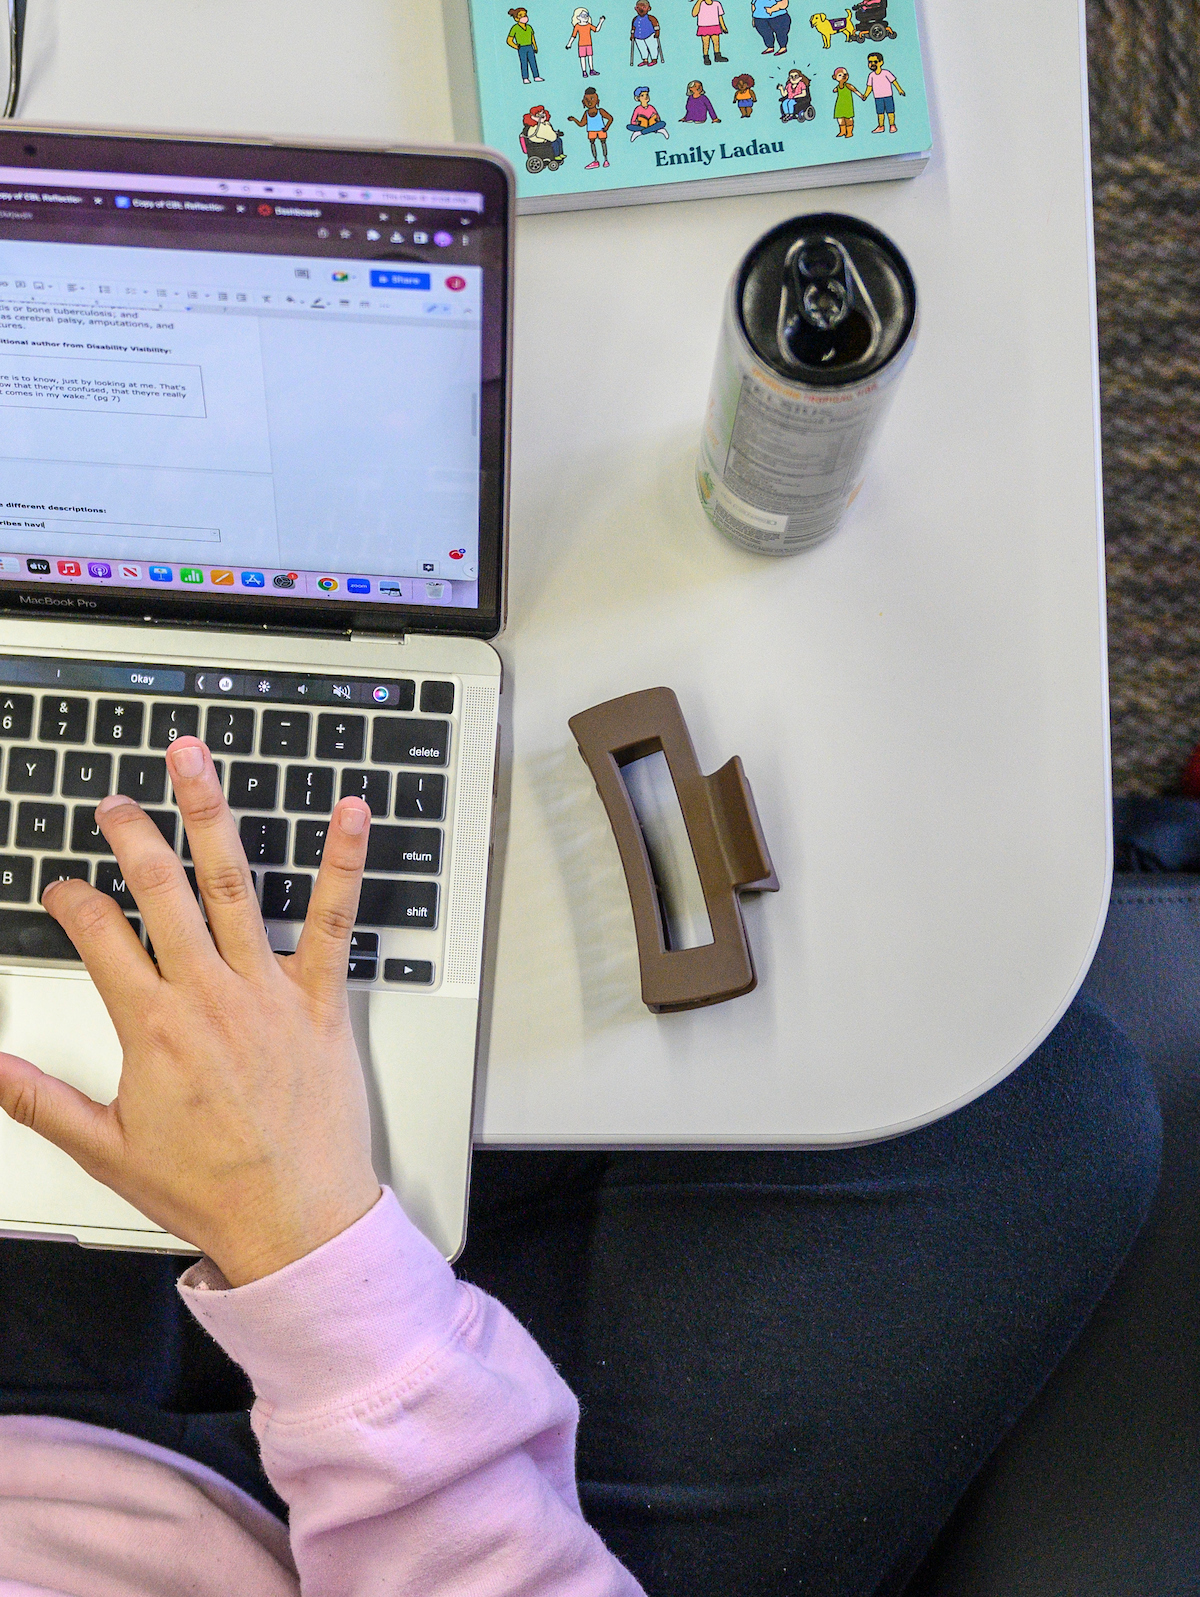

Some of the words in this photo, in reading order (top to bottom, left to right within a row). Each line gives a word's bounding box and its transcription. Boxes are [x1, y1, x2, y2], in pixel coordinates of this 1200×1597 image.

[655, 146, 715, 166] Emily
[720, 139, 784, 159] Ladau
[32, 375, 58, 384] know,
[80, 378, 91, 386] by
[93, 379, 125, 388] looking
[66, 385, 108, 394] confused,
[47, 504, 106, 513] descriptions:
[19, 596, 74, 606] MacBook
[78, 599, 97, 608] Pro
[131, 674, 155, 685] Okay
[3, 715, 12, 729] 6
[58, 722, 67, 735] 7
[113, 725, 122, 738] 8
[224, 732, 233, 745] 0
[409, 746, 440, 757] delete
[26, 763, 36, 776] Y
[81, 767, 92, 781] U
[248, 778, 258, 791] P
[34, 818, 46, 832] H
[403, 851, 432, 861] return
[2, 871, 13, 884] B
[407, 907, 428, 917] shift
